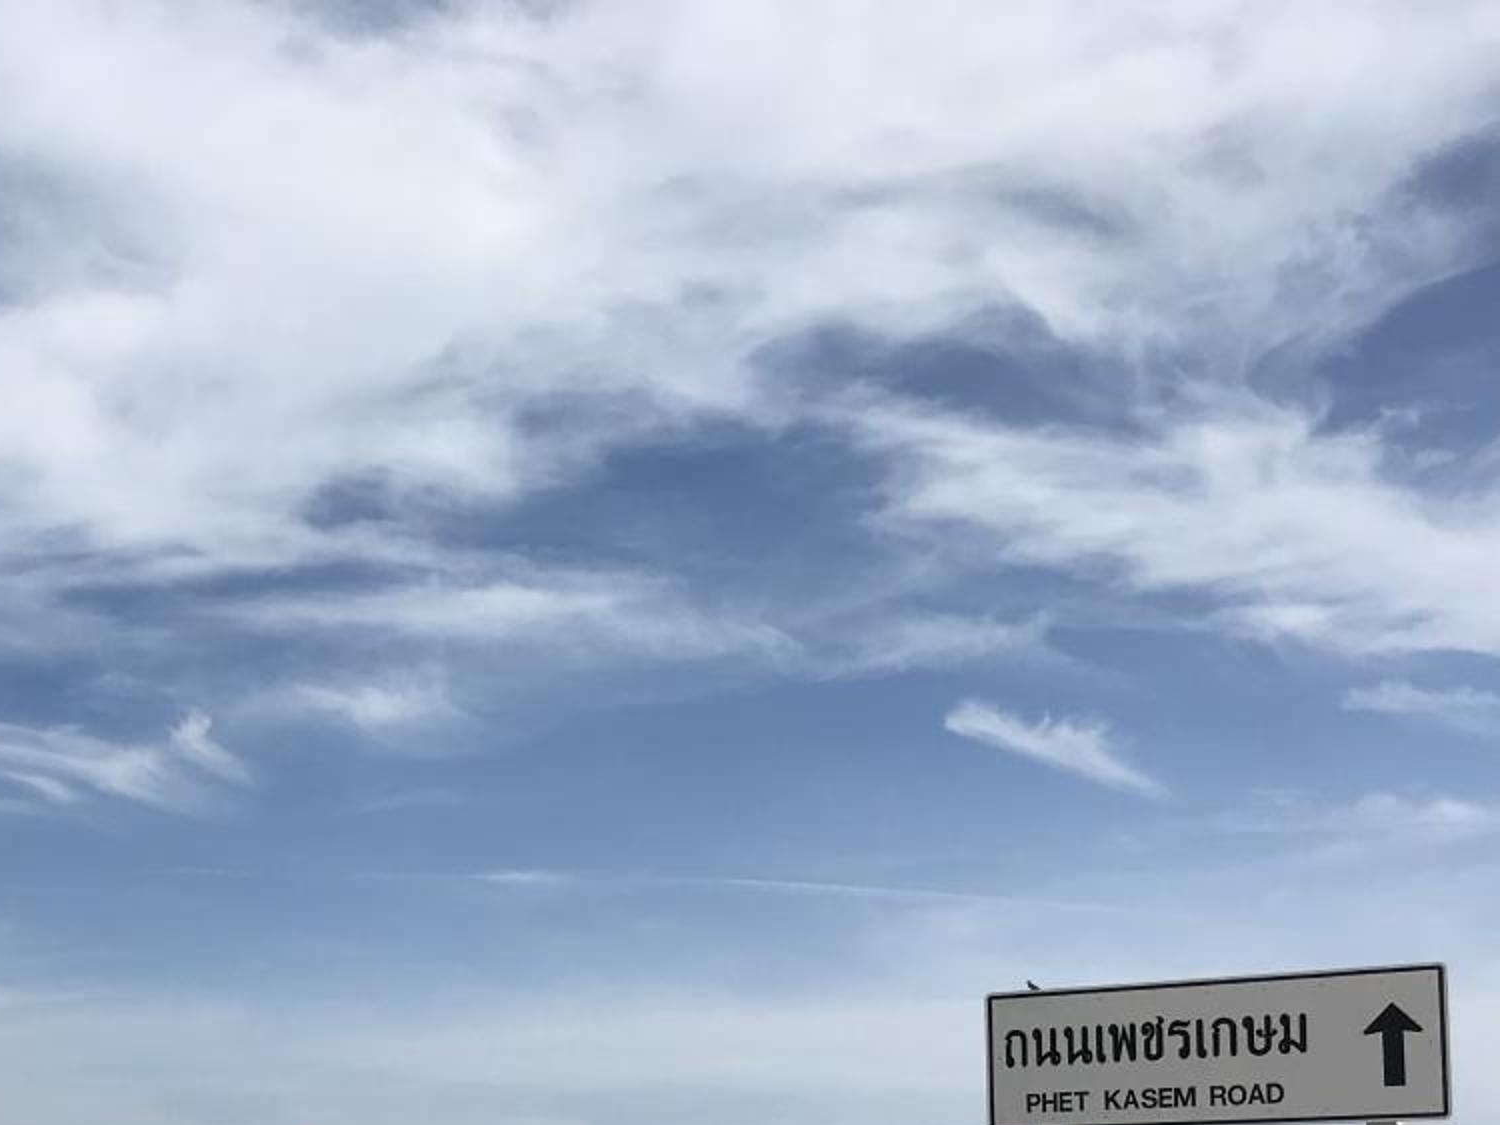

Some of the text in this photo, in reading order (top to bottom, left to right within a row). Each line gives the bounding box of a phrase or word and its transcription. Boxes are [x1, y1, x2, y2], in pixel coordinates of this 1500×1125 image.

[1003, 1012, 1308, 1069] ถนนเพชรเกษม
[1025, 1082, 1285, 1113] PHET KASEM ROAD
